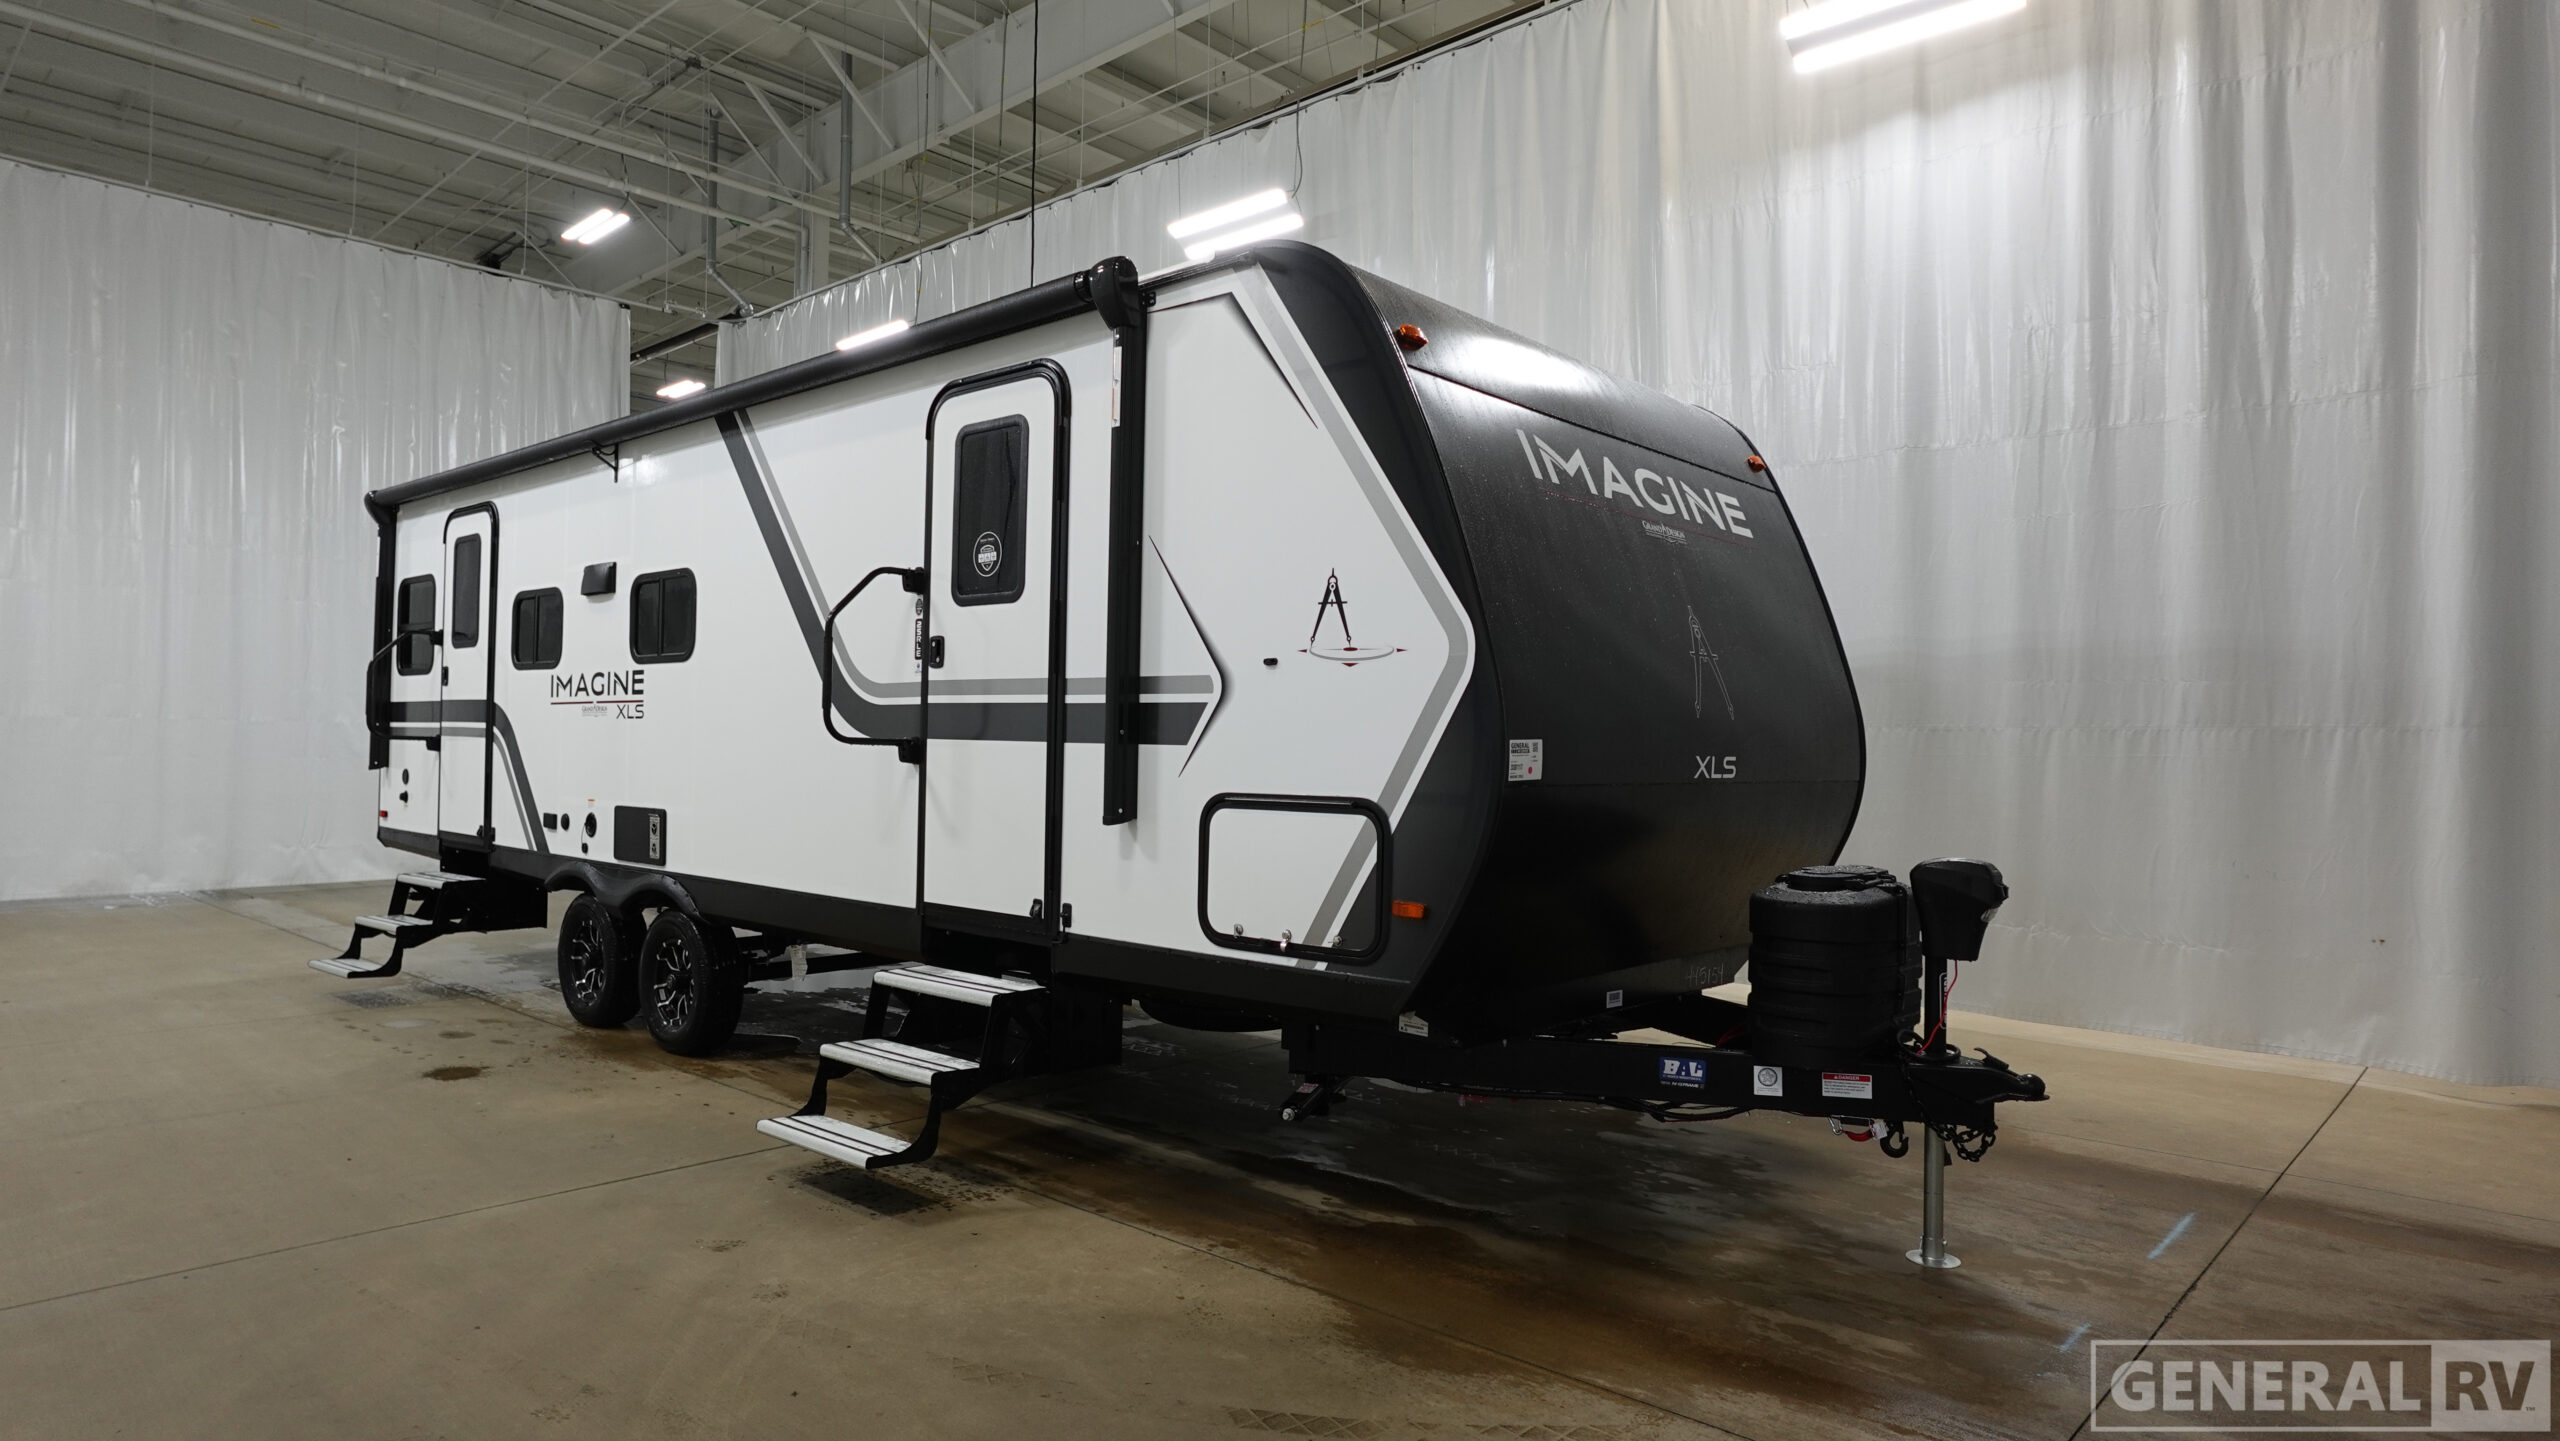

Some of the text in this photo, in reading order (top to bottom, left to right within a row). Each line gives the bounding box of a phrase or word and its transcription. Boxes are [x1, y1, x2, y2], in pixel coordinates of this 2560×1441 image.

[1516, 428, 1754, 538] IMAGINE
[550, 670, 645, 698] IMAGINE
[616, 704, 645, 719] XLS
[1694, 755, 1737, 779] XLS
[1663, 1059, 1703, 1078] BAL
